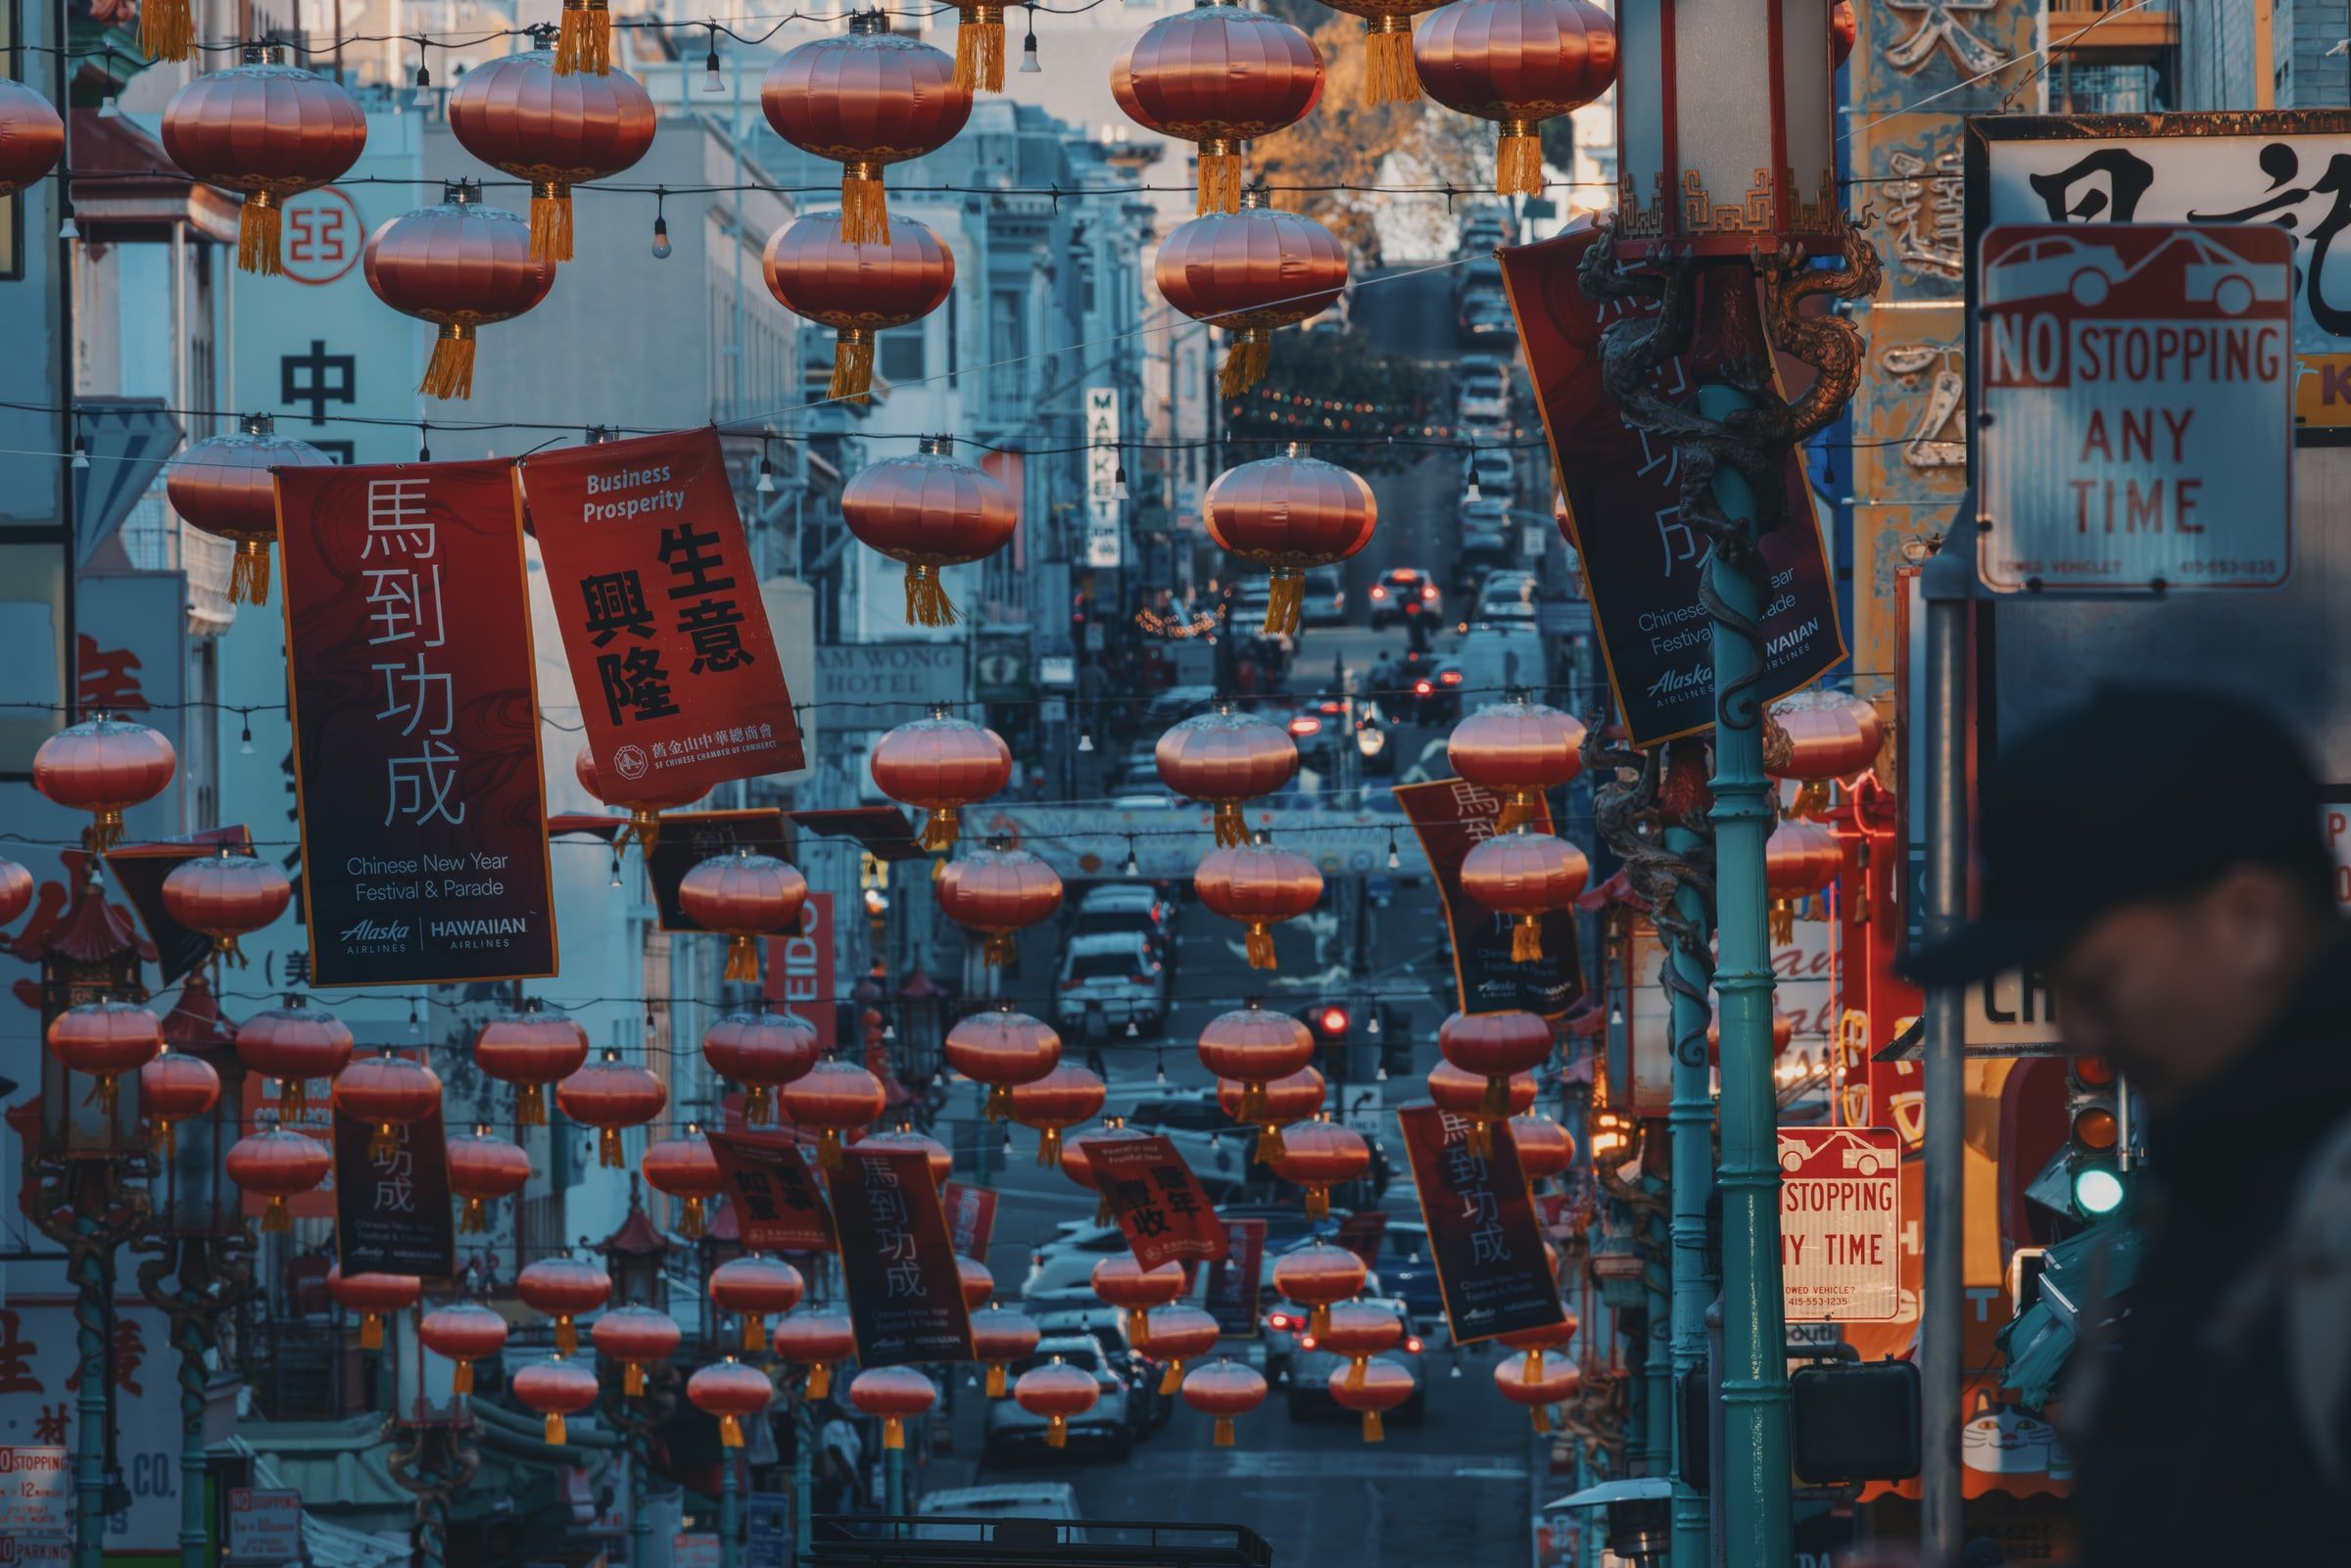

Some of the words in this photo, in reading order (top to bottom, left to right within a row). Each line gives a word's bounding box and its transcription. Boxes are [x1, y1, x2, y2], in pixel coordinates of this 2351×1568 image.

[1991, 312, 2058, 383] NO
[2079, 327, 2279, 383] STOPPING
[2080, 408, 2196, 463] ANY
[1094, 395, 1112, 516] MARKET
[587, 465, 672, 495] Business
[583, 490, 685, 523] Prosperity
[2069, 480, 2205, 534] TIME
[1638, 602, 1709, 632] Chinese
[1771, 567, 1794, 588] ear
[1651, 621, 1714, 656] Festival
[1766, 594, 1797, 618] ade
[360, 478, 465, 828] 馬到功成
[815, 649, 854, 669] AM
[864, 648, 953, 670] WONG
[1765, 642, 1811, 674] IRLINES
[825, 673, 925, 694] HOTEL
[1647, 663, 1713, 697] Alaska
[1655, 684, 1714, 708] AIRLINES
[346, 856, 418, 877] Chinese
[423, 854, 465, 873] New
[470, 851, 509, 870] Year
[356, 880, 419, 902] Festival
[424, 879, 440, 899] &
[444, 878, 504, 898] Parade
[339, 918, 410, 942] Alaska
[430, 917, 527, 937] HAWAIIAN
[347, 943, 407, 955] AIRLINES
[450, 938, 510, 950] AIRLINES
[1786, 1182, 1893, 1212] STOPPING
[862, 1156, 928, 1298] 馬到功成
[1825, 1234, 1883, 1265] TIME
[1785, 1286, 1809, 1295] OWED
[1813, 1286, 1856, 1295] VEHICLE?
[1788, 1297, 1848, 1306] 415-553-1235
[0, 1449, 11, 1472] O
[13, 1454, 69, 1470] STOPPING
[133, 1452, 176, 1498] CO.
